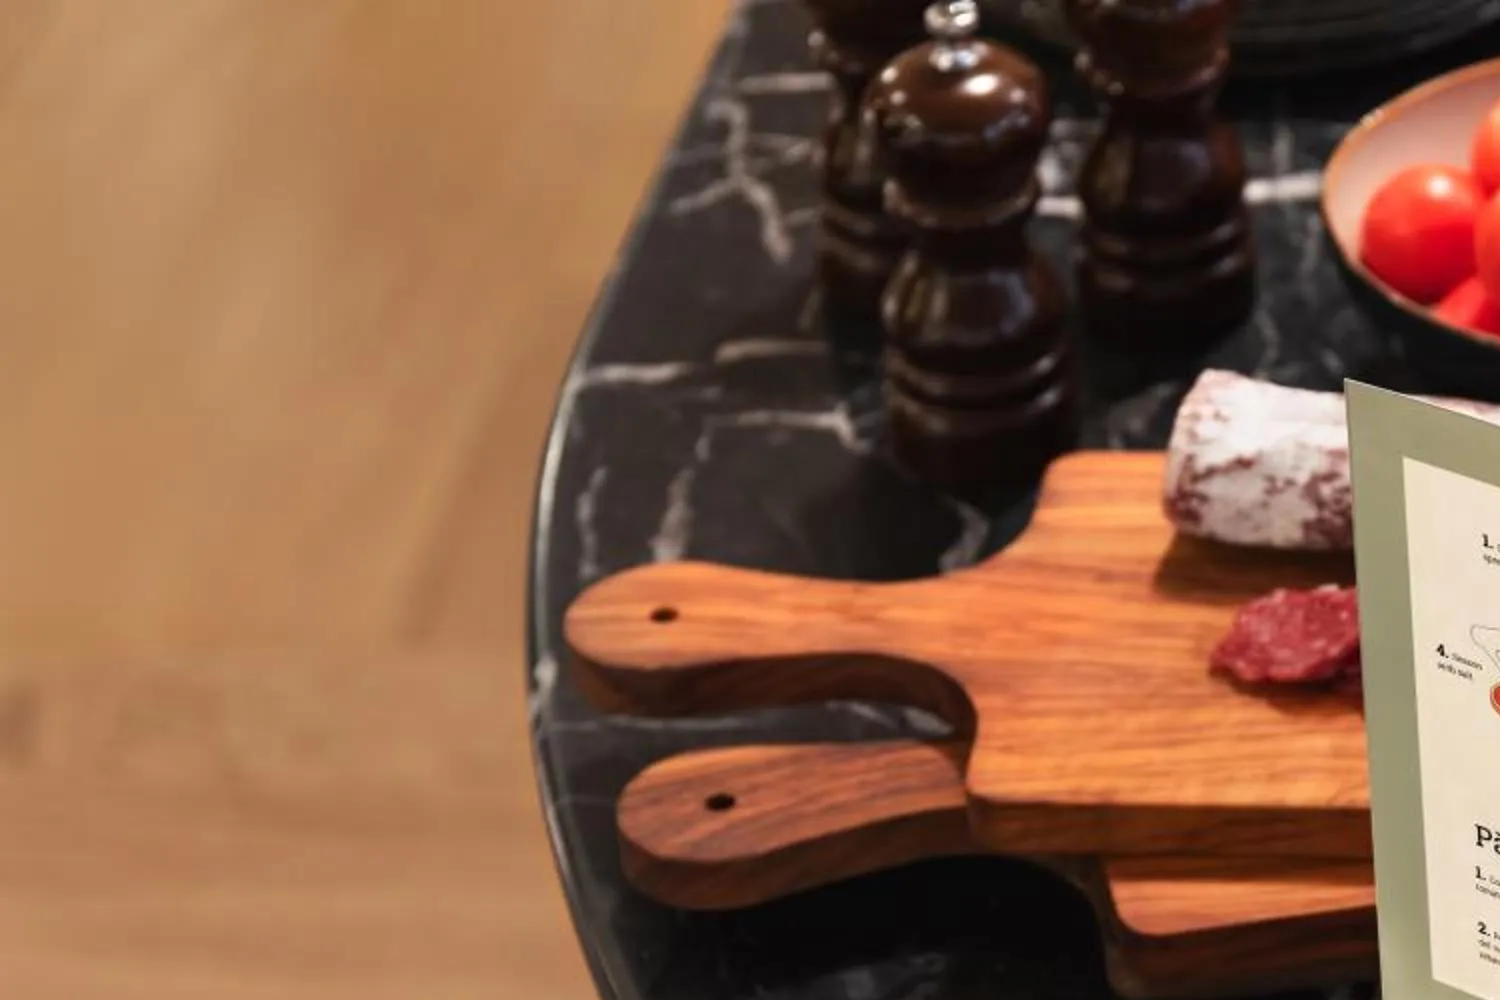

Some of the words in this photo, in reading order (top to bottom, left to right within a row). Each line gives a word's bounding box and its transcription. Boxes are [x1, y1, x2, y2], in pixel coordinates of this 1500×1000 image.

[1482, 533, 1494, 549] 1.
[1436, 643, 1450, 659] 4.
[1475, 864, 1487, 881] 1.
[1477, 921, 1491, 937] 2.
